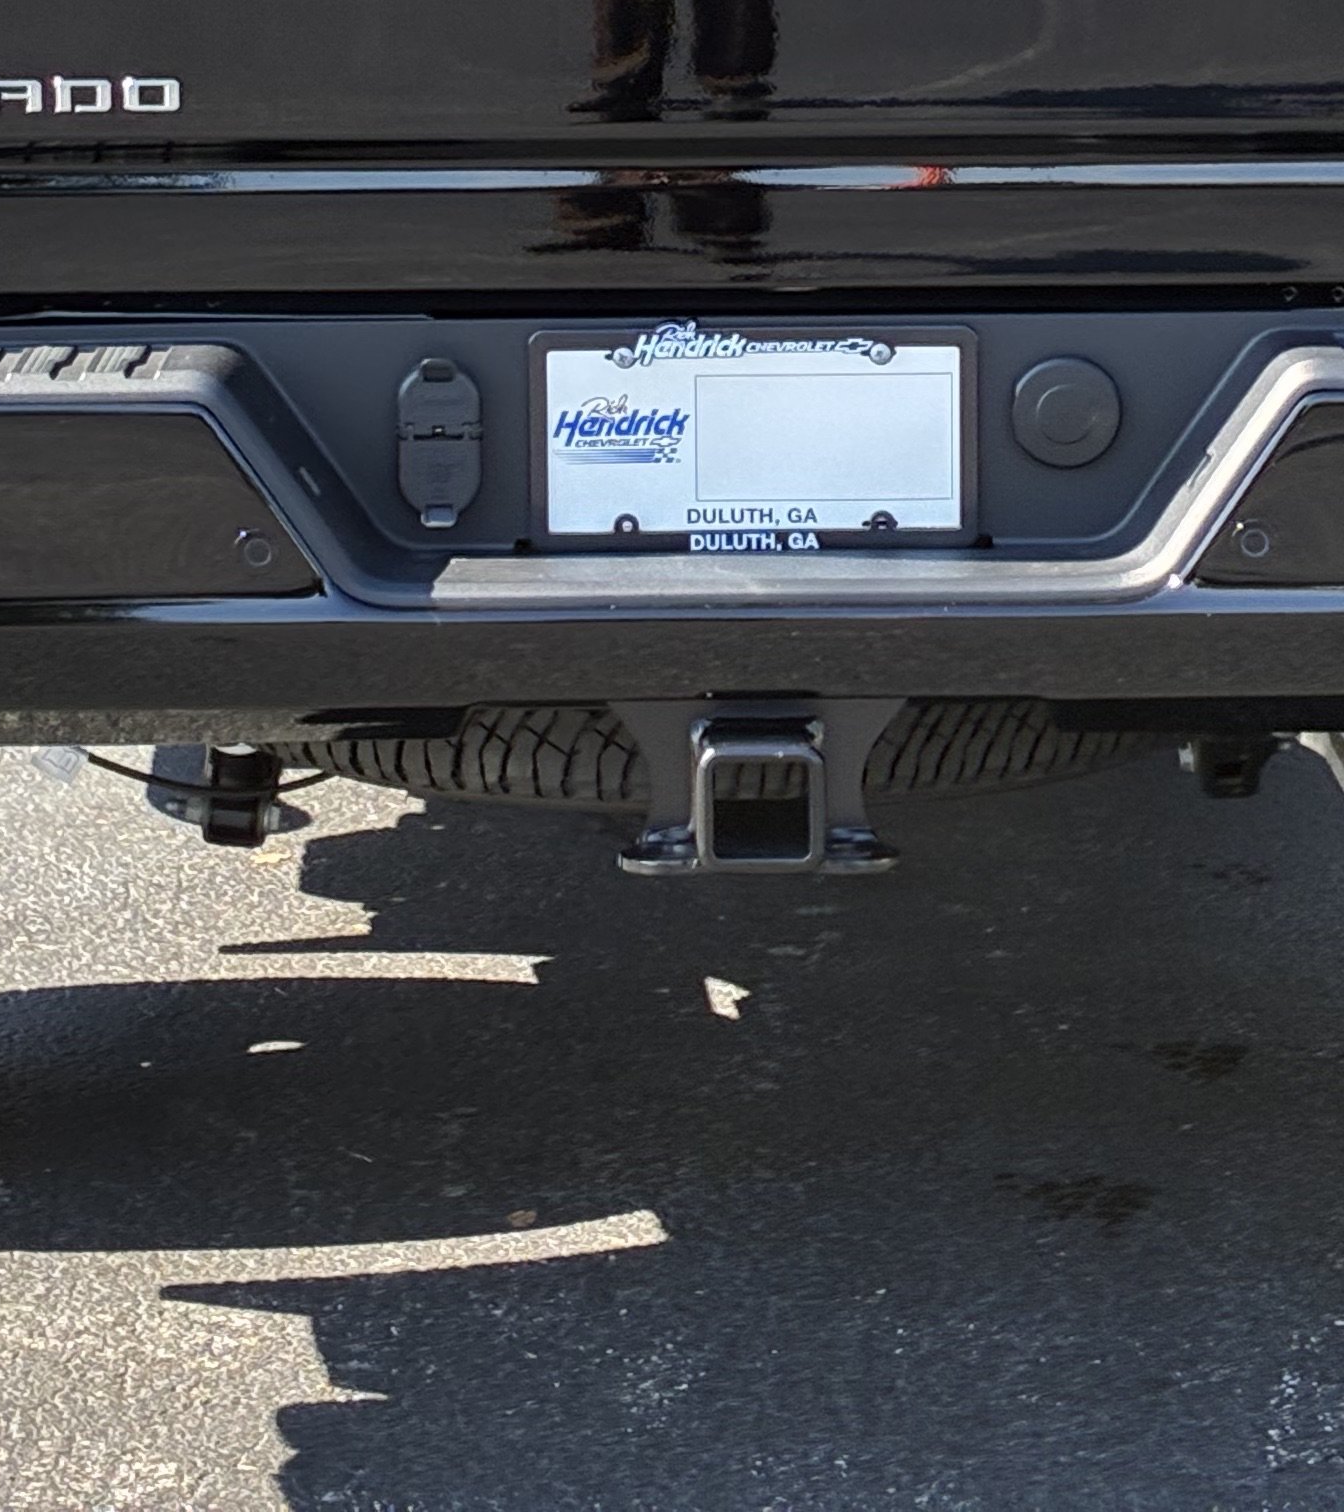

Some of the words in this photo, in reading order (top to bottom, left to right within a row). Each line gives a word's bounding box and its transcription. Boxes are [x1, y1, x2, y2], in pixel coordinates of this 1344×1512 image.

[634, 333, 747, 367] Hendrick
[746, 341, 834, 354] CHEVROLET
[580, 393, 629, 418] Rich
[553, 408, 690, 448] Hendrick
[574, 438, 649, 448] CHEVROLET
[686, 508, 781, 526] DULUTH,
[787, 508, 818, 524] GA
[690, 533, 783, 552] DULUTH,
[787, 533, 820, 550] GA
